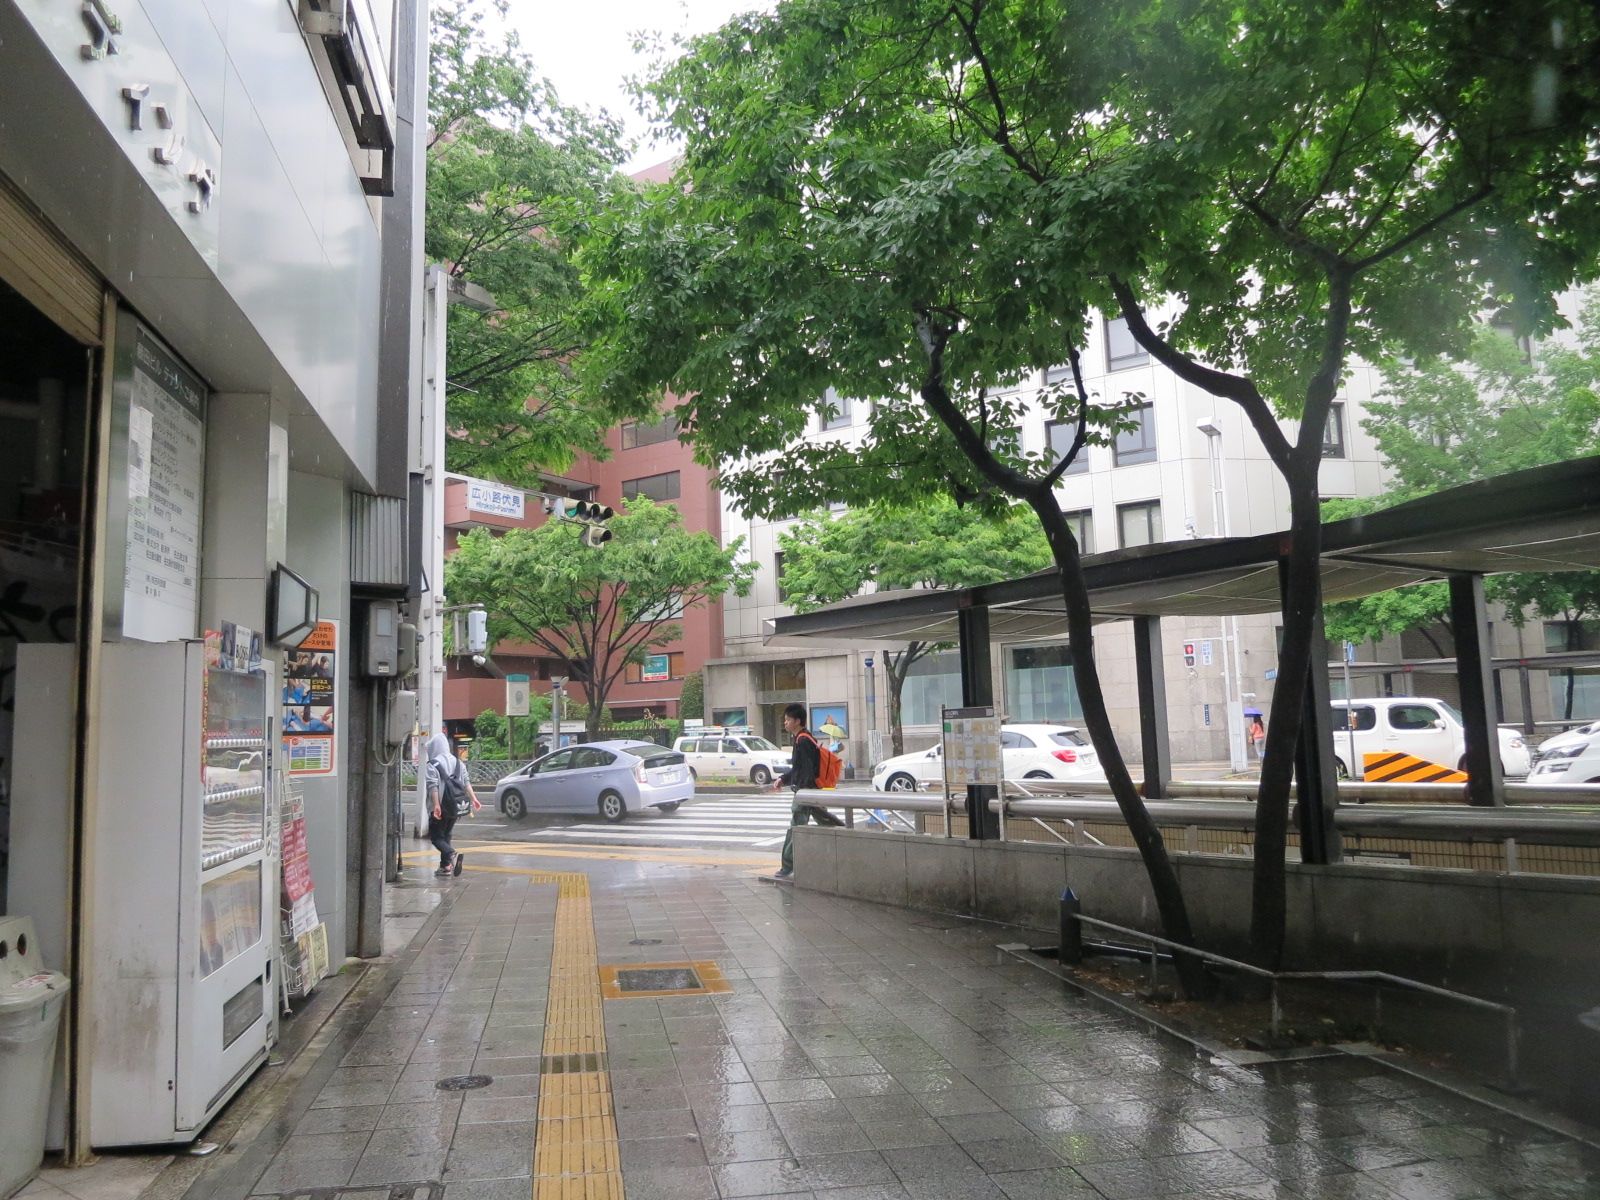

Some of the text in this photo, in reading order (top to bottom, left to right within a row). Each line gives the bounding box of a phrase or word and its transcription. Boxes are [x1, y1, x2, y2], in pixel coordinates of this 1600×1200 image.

[472, 487, 521, 508] 広小路伏見
